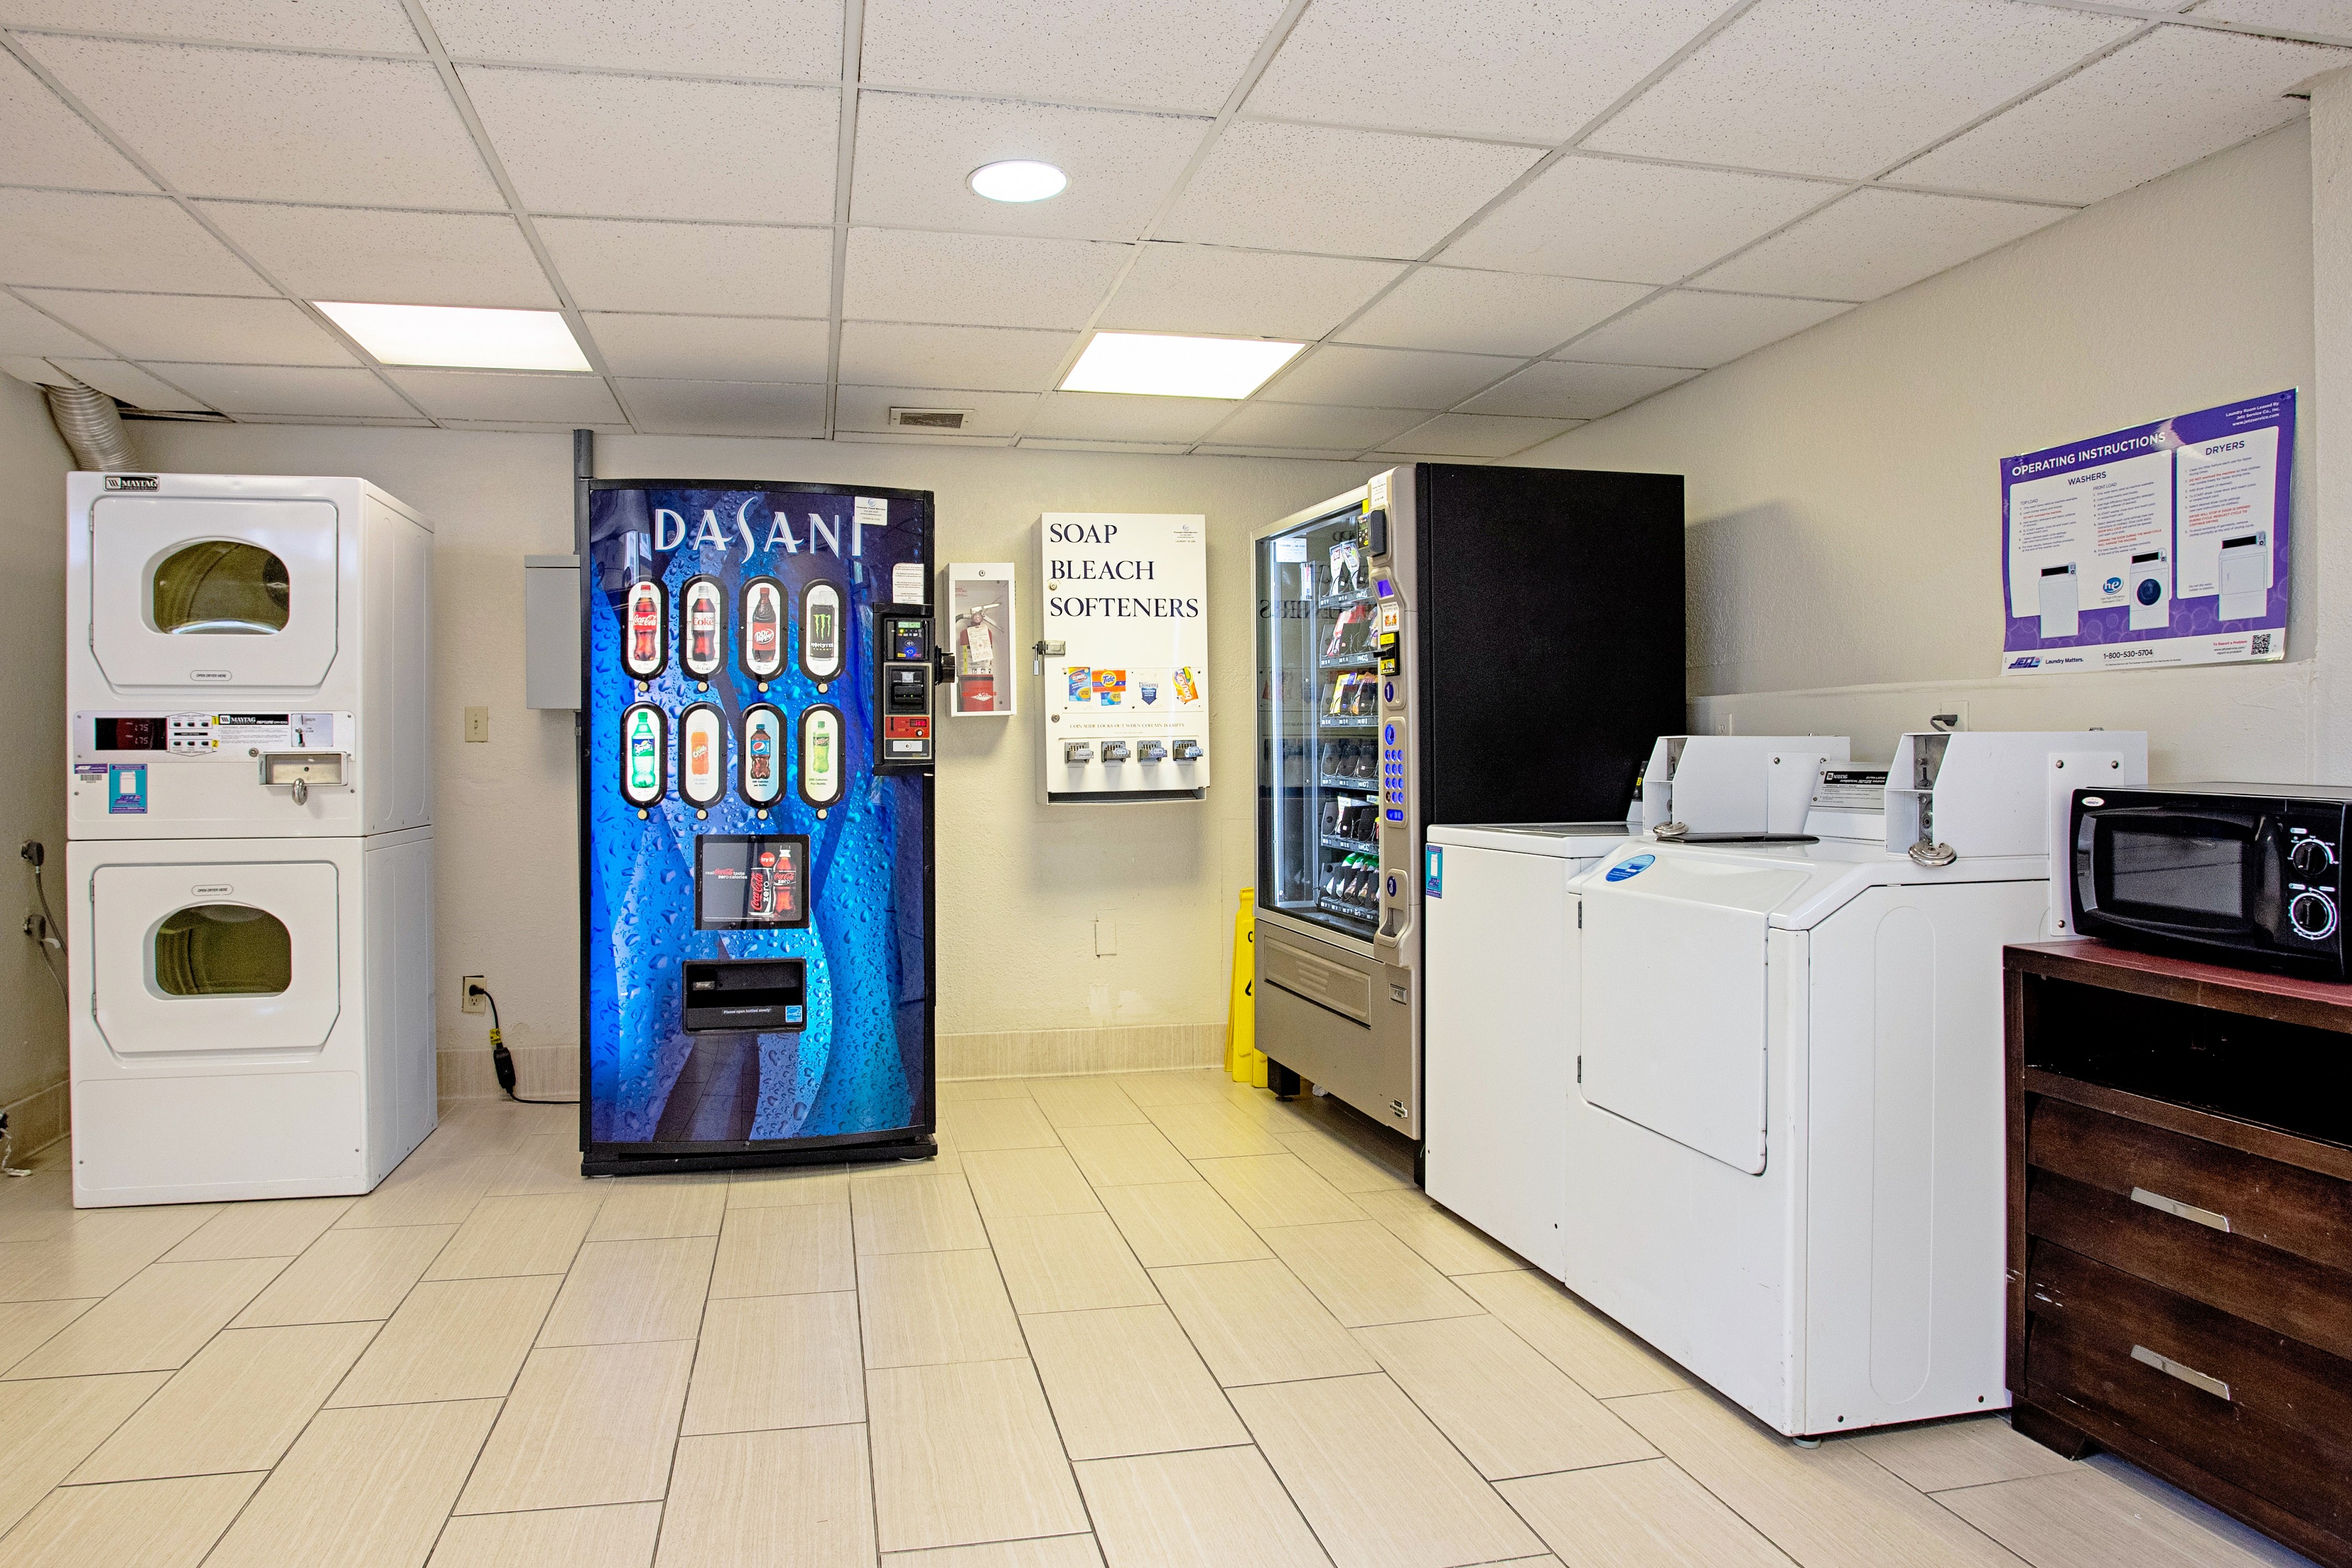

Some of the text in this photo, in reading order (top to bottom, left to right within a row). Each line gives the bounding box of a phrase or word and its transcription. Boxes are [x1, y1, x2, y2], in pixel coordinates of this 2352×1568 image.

[2012, 432, 2166, 477] OPERATING INSTRUCTIONS
[2206, 441, 2244, 455] DRYERS
[2068, 471, 2106, 486] WASHERS
[655, 497, 861, 564] DASANI
[1050, 524, 1117, 544] SOAP
[1051, 560, 1154, 580] BLEACH
[2105, 580, 2119, 590] he
[1051, 597, 1198, 617] SOFTENERS
[633, 614, 656, 626] Coca-Cola
[692, 617, 714, 626] Coke
[2103, 649, 2153, 660] 1-800-530-5704
[1103, 674, 1115, 684] Tide
[1386, 685, 1390, 698] 1
[750, 871, 763, 910] Coca-Cola
[1389, 879, 1393, 893] 3
